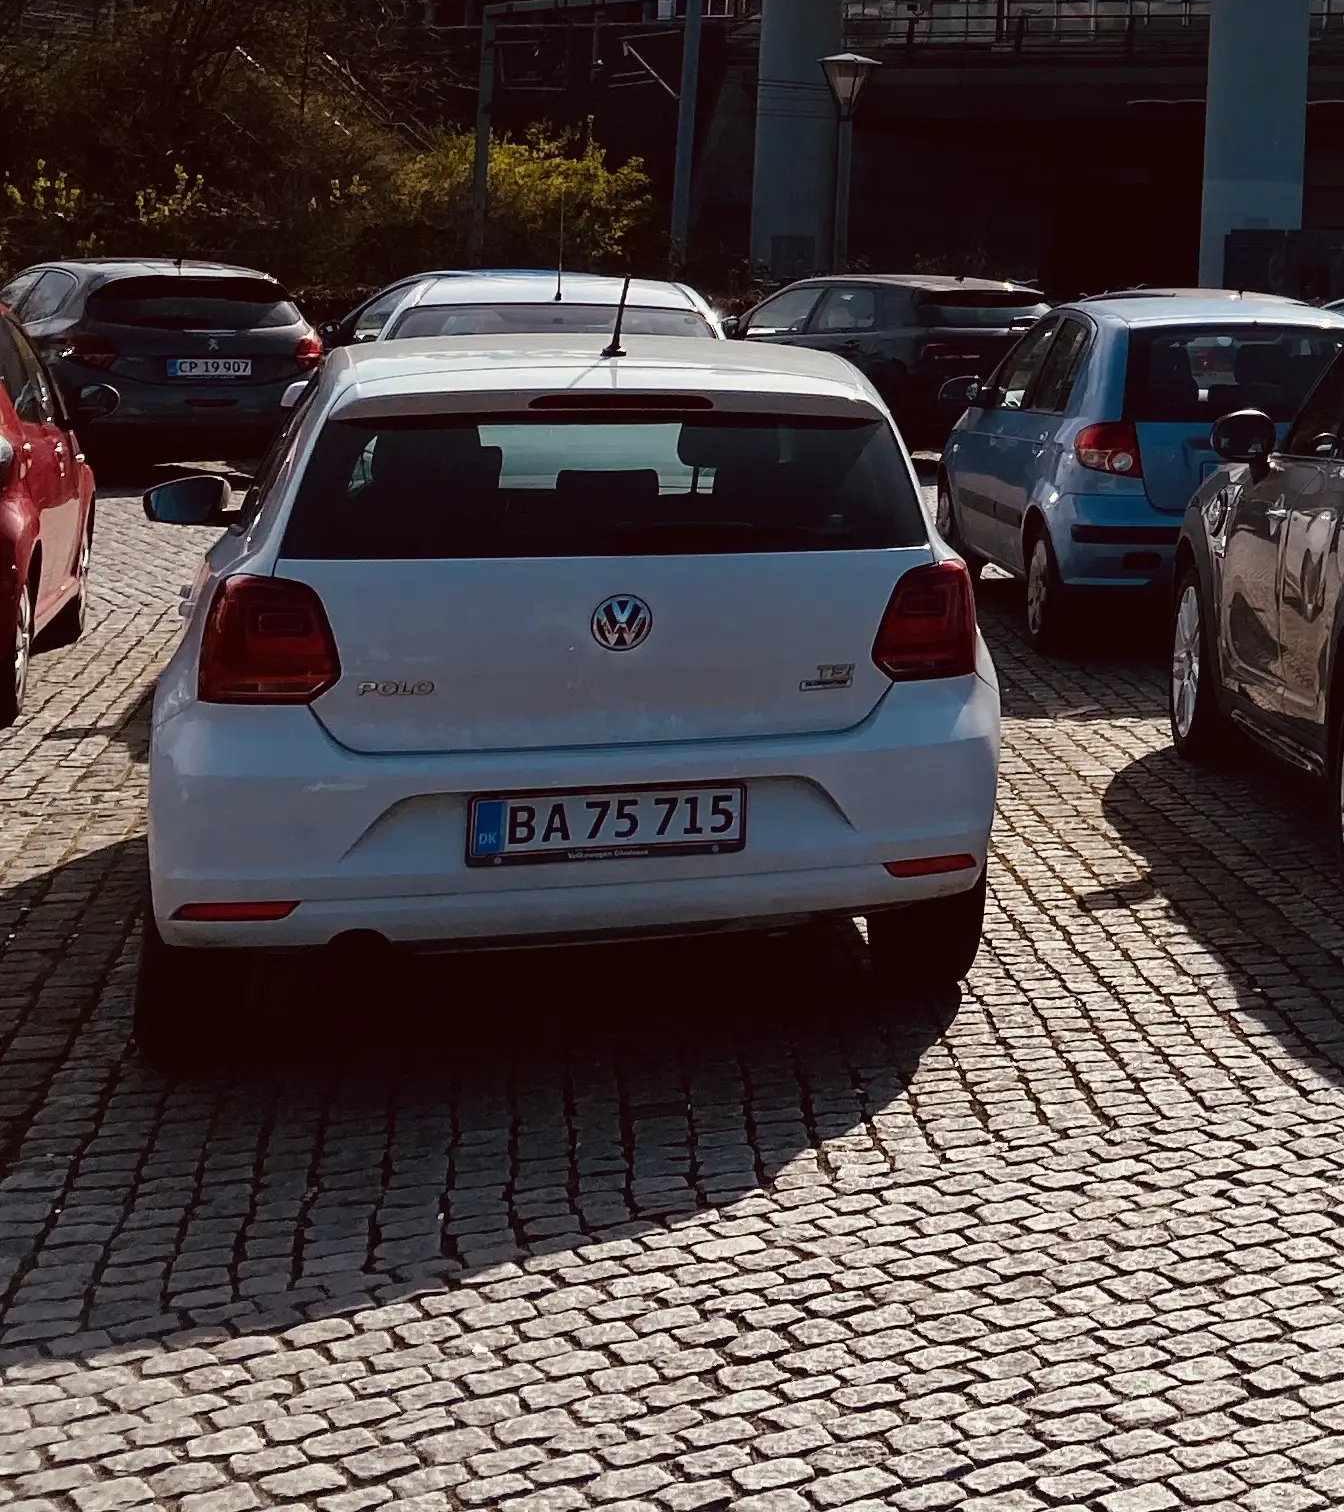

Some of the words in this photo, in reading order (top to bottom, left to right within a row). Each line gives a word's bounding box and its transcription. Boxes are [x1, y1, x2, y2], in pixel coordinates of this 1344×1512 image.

[179, 361, 198, 373] CP
[203, 361, 220, 373] 19
[222, 361, 249, 373] 907
[356, 681, 435, 696] POLO
[508, 803, 571, 845] BA
[585, 799, 639, 839] 75
[654, 794, 734, 836] 715
[478, 833, 497, 845] DK
